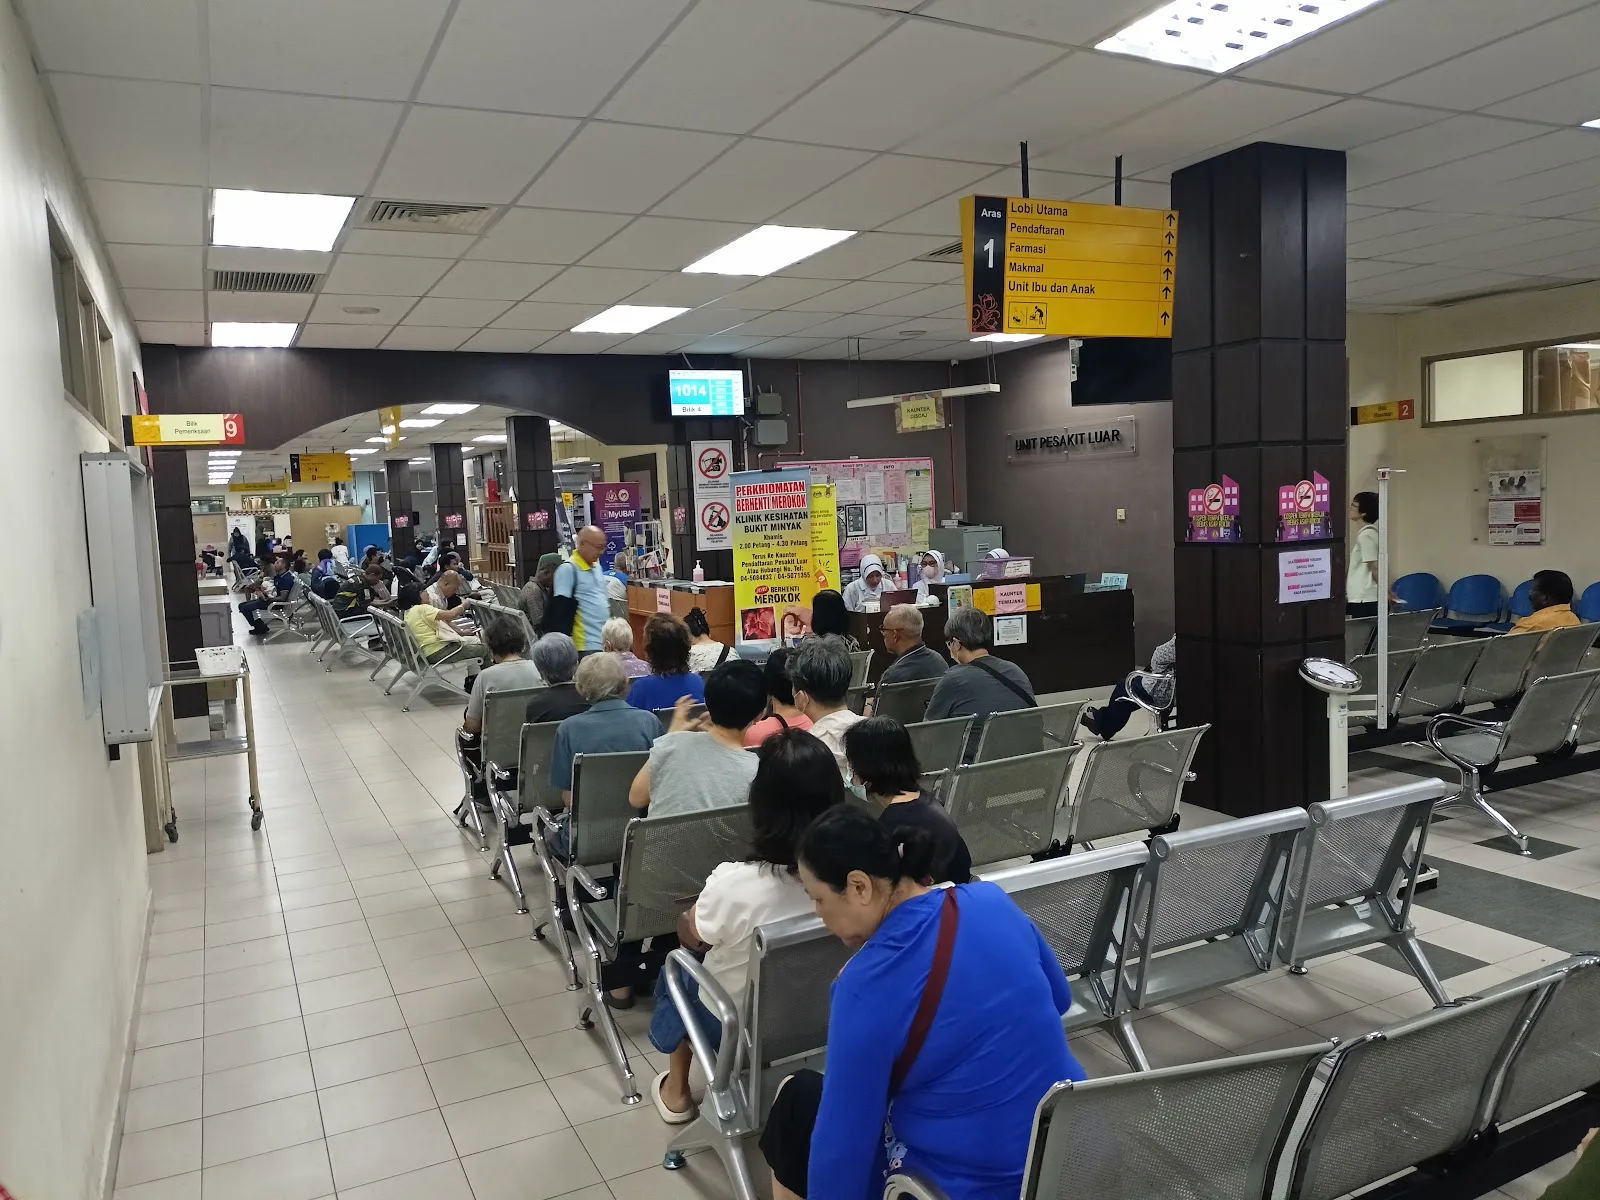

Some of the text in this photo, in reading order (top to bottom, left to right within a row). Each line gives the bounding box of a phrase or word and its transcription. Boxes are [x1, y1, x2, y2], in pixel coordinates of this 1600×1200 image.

[981, 208, 1002, 218] Aras
[1011, 202, 1068, 216] Lobi Utama
[1010, 223, 1064, 236] Pendaftaran
[984, 239, 994, 268] 1
[1010, 242, 1046, 254] Farmasi
[1009, 262, 1044, 273] Makmal
[1008, 281, 1095, 294] Unit Ibu dan Anak
[675, 384, 706, 396] 1014
[1402, 404, 1408, 416] 2
[226, 420, 238, 438] 9
[1016, 429, 1120, 450] UNIT PESAKIT LUAR
[736, 481, 805, 496] PERKHIDMATAN
[736, 494, 806, 512] BERHENTI MEROKOK
[608, 510, 636, 519] MyUBAT
[736, 514, 762, 524] KLINIK
[764, 512, 808, 522] KESIHATAN
[744, 524, 767, 533] BUKIT
[770, 522, 802, 532] MINYAK
[754, 592, 800, 604] MEROKOK
